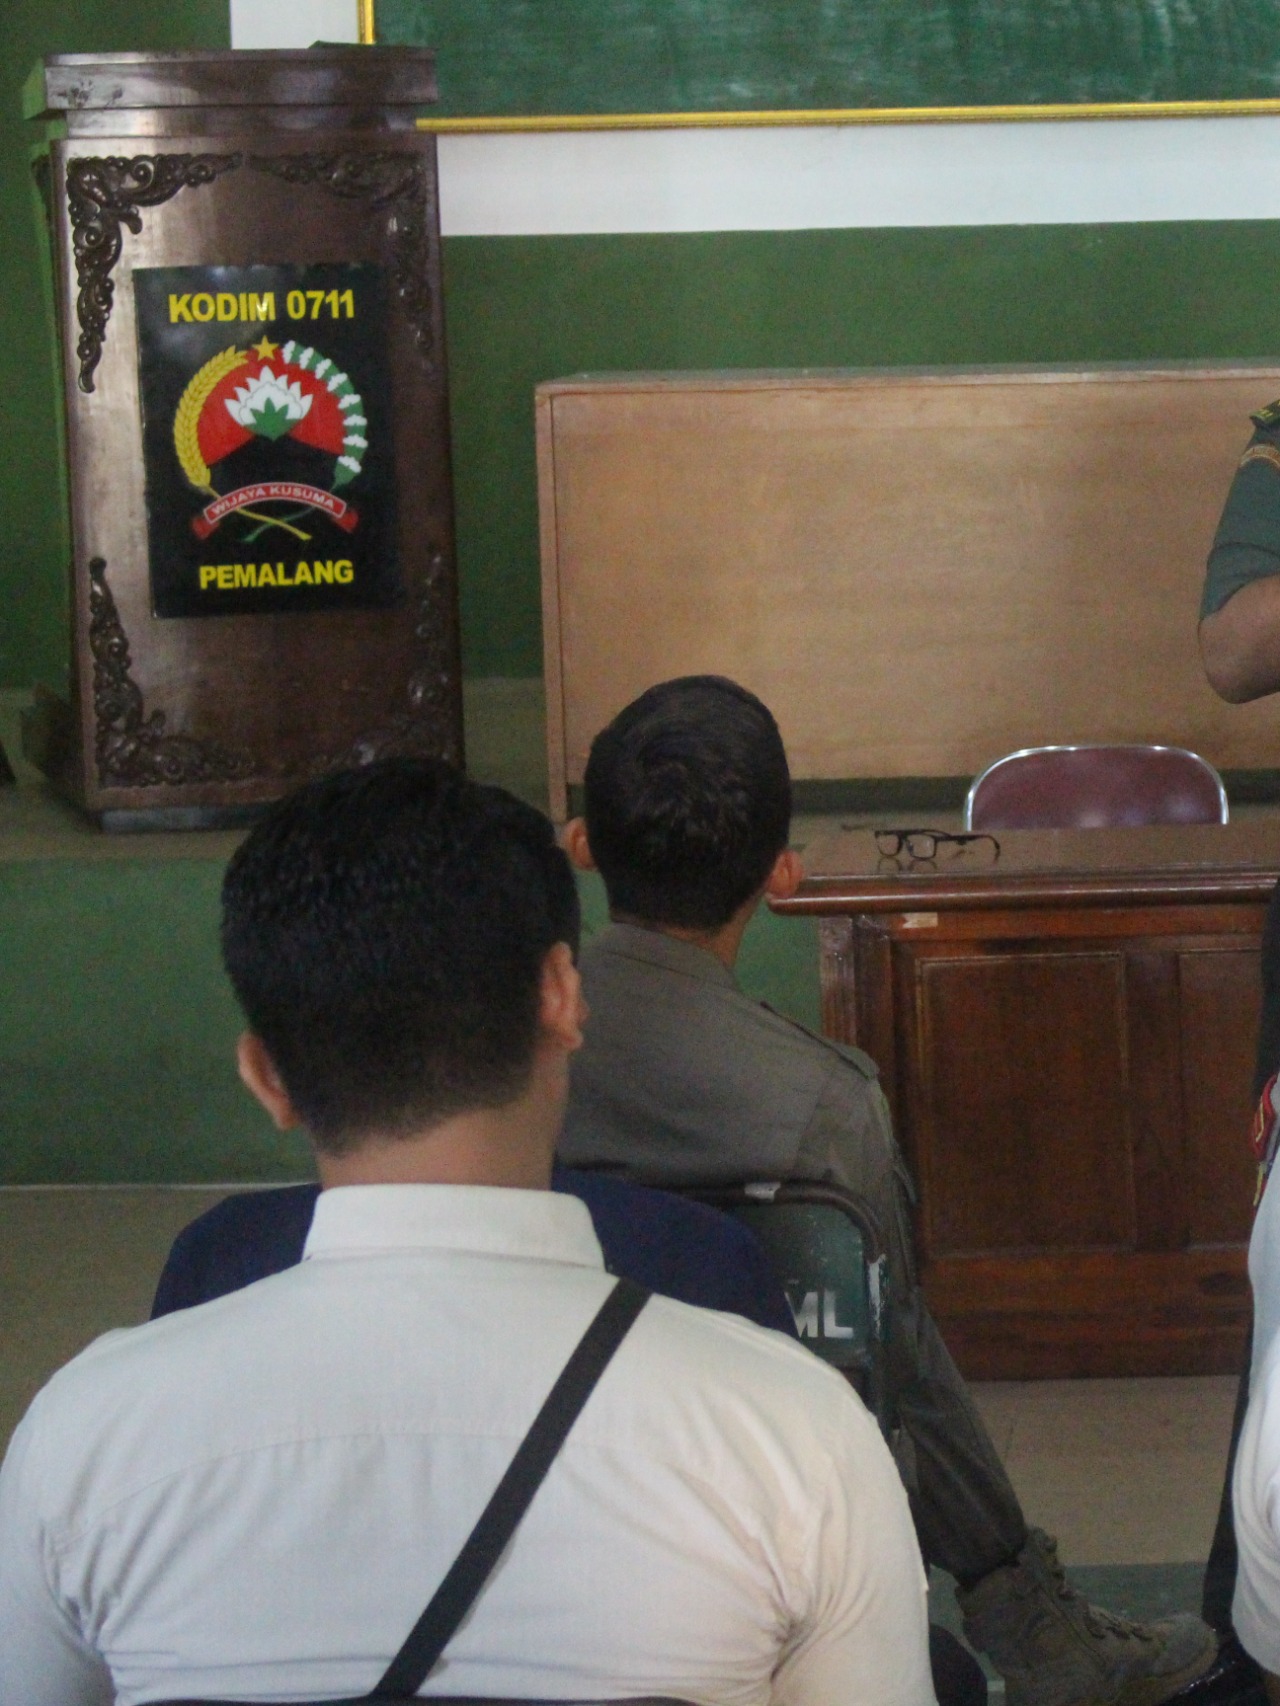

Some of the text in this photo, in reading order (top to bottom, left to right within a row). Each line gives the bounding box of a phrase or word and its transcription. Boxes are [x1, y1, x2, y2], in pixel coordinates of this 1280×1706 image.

[168, 289, 355, 323] KODIM 0711
[211, 485, 335, 515] WIJAYA KUSUMA
[199, 559, 355, 590] PEMALANG
